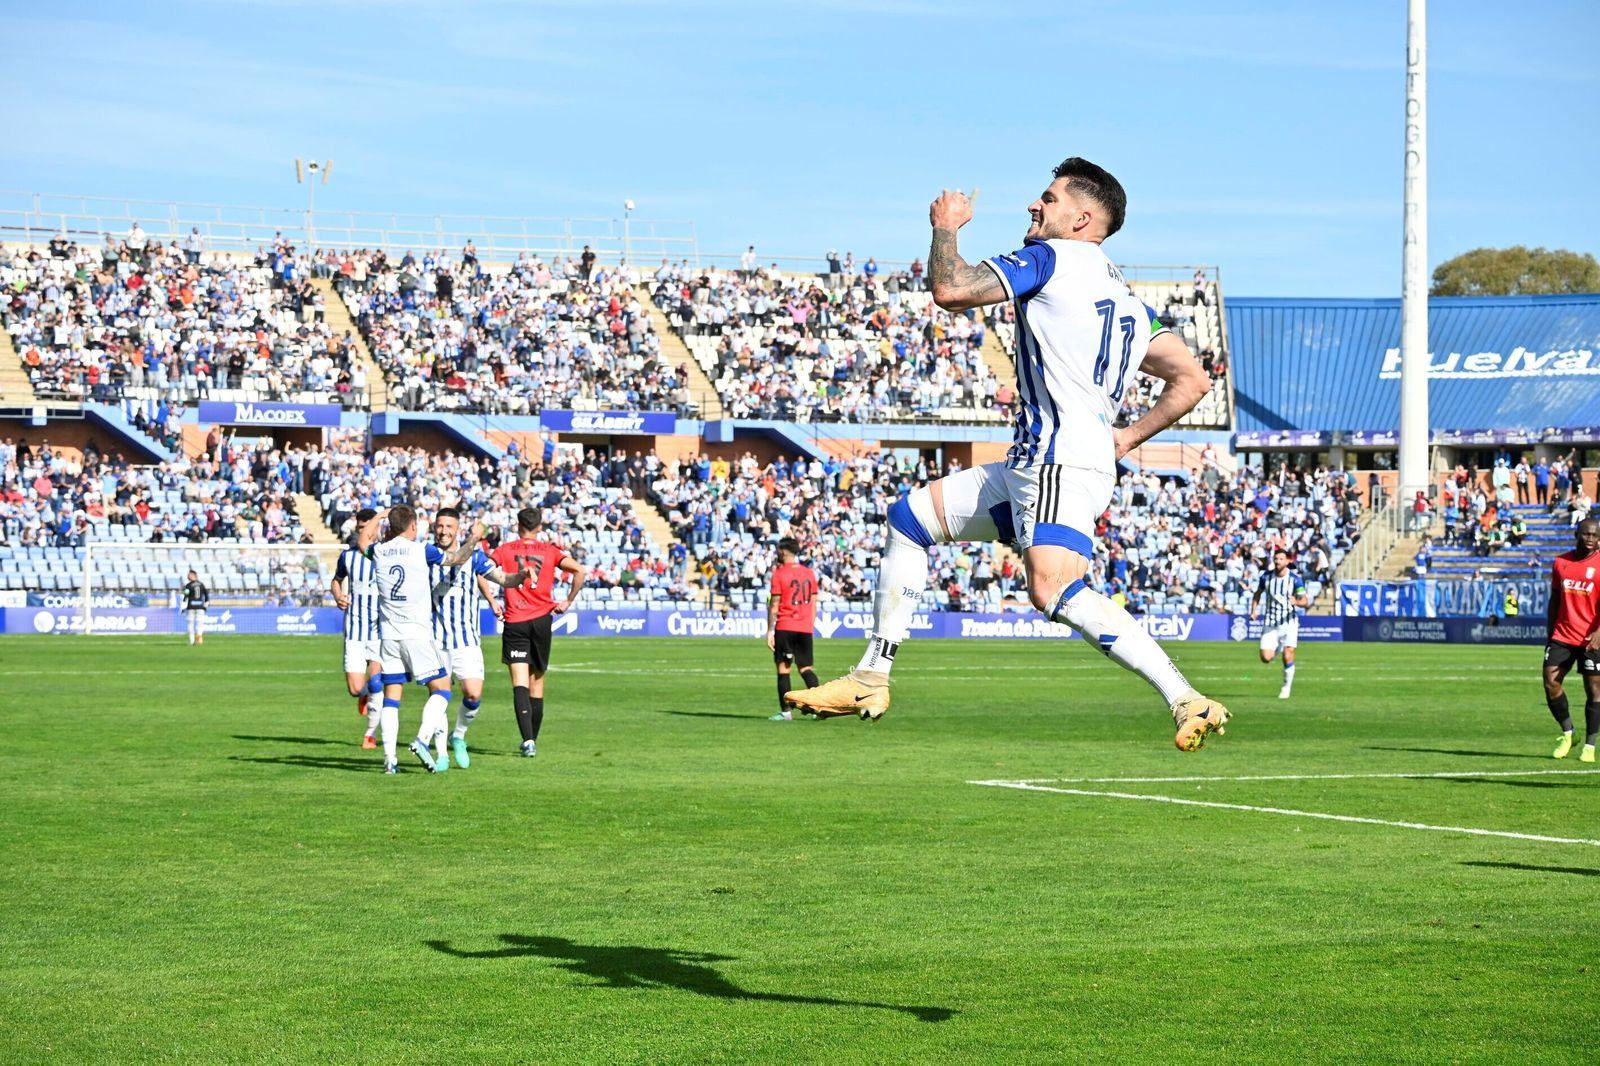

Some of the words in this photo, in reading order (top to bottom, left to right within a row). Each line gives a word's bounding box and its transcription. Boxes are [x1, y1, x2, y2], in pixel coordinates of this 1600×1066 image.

[1093, 298, 1136, 403] 11
[388, 564, 407, 601] 2
[790, 579, 812, 605] 20
[43, 596, 130, 608] COMPIANCE
[597, 615, 645, 633] Veyser
[668, 611, 768, 638] Cruzcamp
